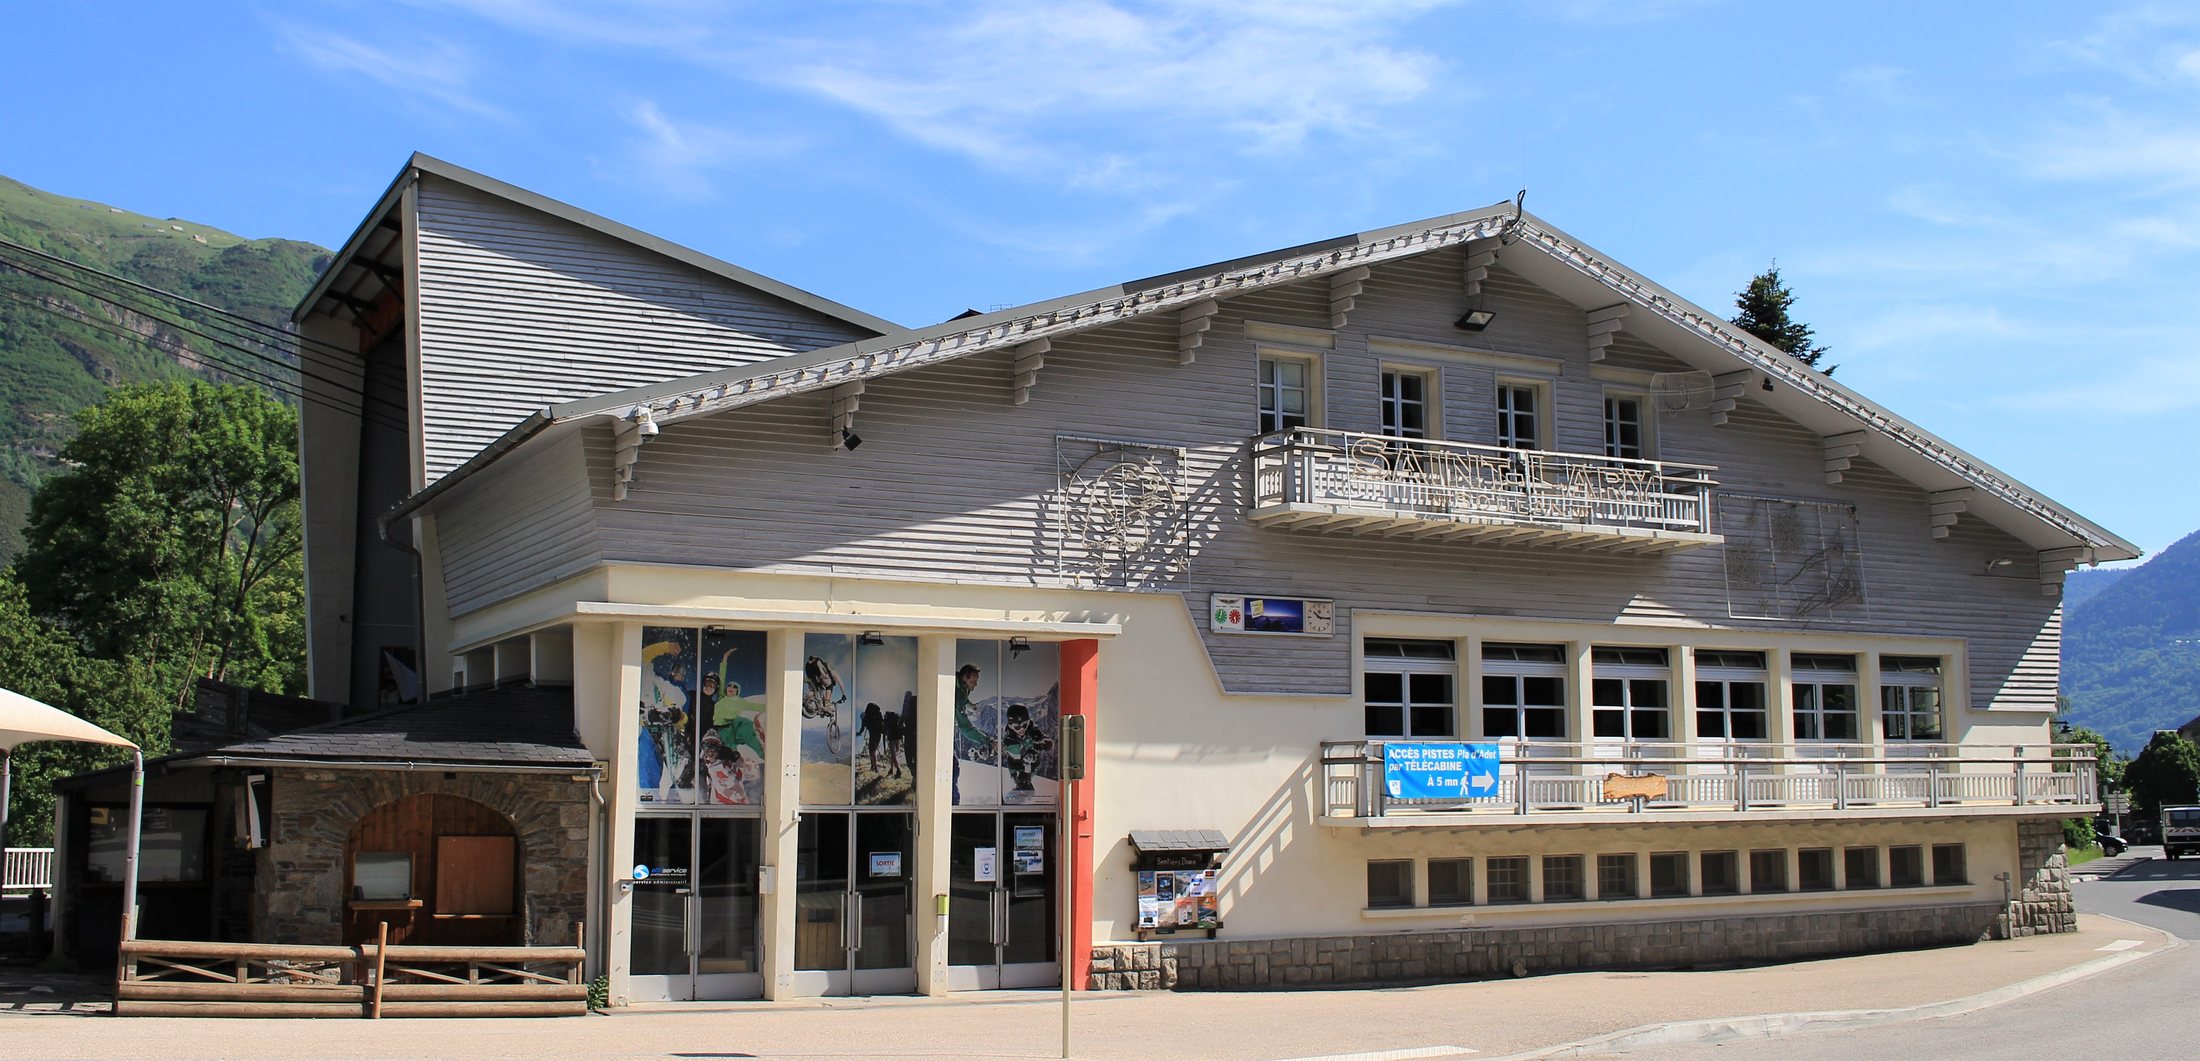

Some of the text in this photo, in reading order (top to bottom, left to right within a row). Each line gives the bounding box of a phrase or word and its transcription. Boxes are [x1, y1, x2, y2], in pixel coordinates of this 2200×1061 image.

[1388, 747, 1419, 759] ACCÈS
[1422, 749, 1454, 759] PISTES
[1457, 749, 1469, 759] Pla
[1388, 759, 1462, 773] par TÉLÉCABINE
[1427, 774, 1458, 786] À 5 mn
